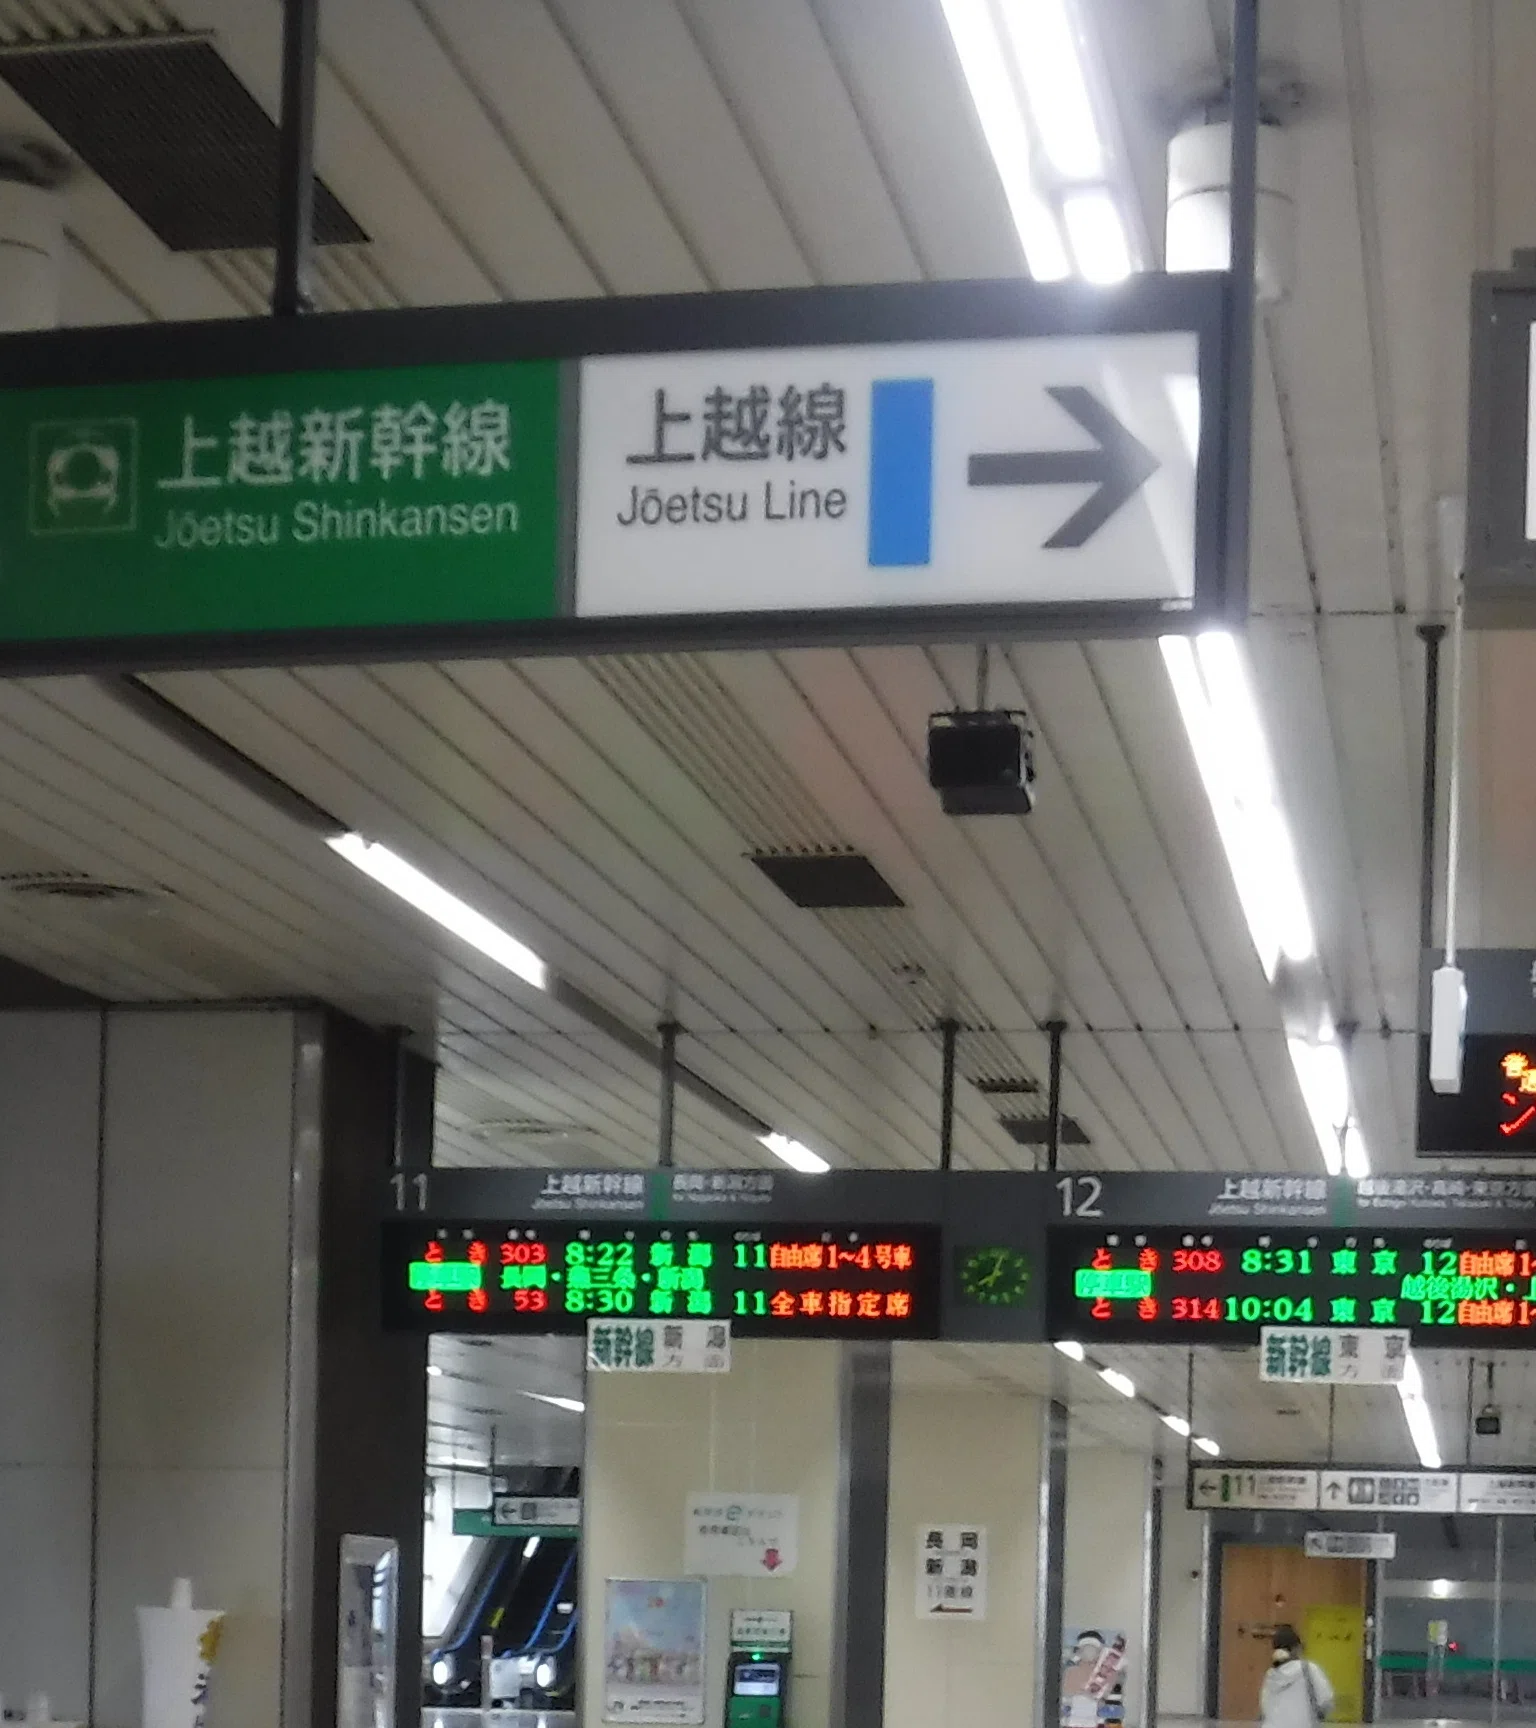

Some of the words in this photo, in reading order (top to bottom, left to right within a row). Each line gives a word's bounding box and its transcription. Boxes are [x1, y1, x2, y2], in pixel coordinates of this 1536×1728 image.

[156, 398, 513, 490] 上越新幹線
[625, 382, 848, 466] 上越線
[291, 499, 520, 544] Shinkansen
[616, 485, 749, 527] Jōetsu
[763, 480, 848, 522] Line
[390, 1172, 428, 1211] 11
[1055, 1176, 1105, 1218] 12
[500, 1242, 548, 1265] 303
[565, 1242, 634, 1266] 8:22
[733, 1243, 767, 1269] 11
[1171, 1250, 1225, 1273] 308
[1240, 1249, 1313, 1275] 8:31
[1420, 1250, 1459, 1277] 12
[513, 1290, 548, 1313] 53
[564, 1289, 633, 1314] 8:30
[733, 1290, 767, 1317] 11
[1171, 1297, 1222, 1322] 314
[1223, 1297, 1314, 1323] 10:04
[1420, 1299, 1456, 1326] 12
